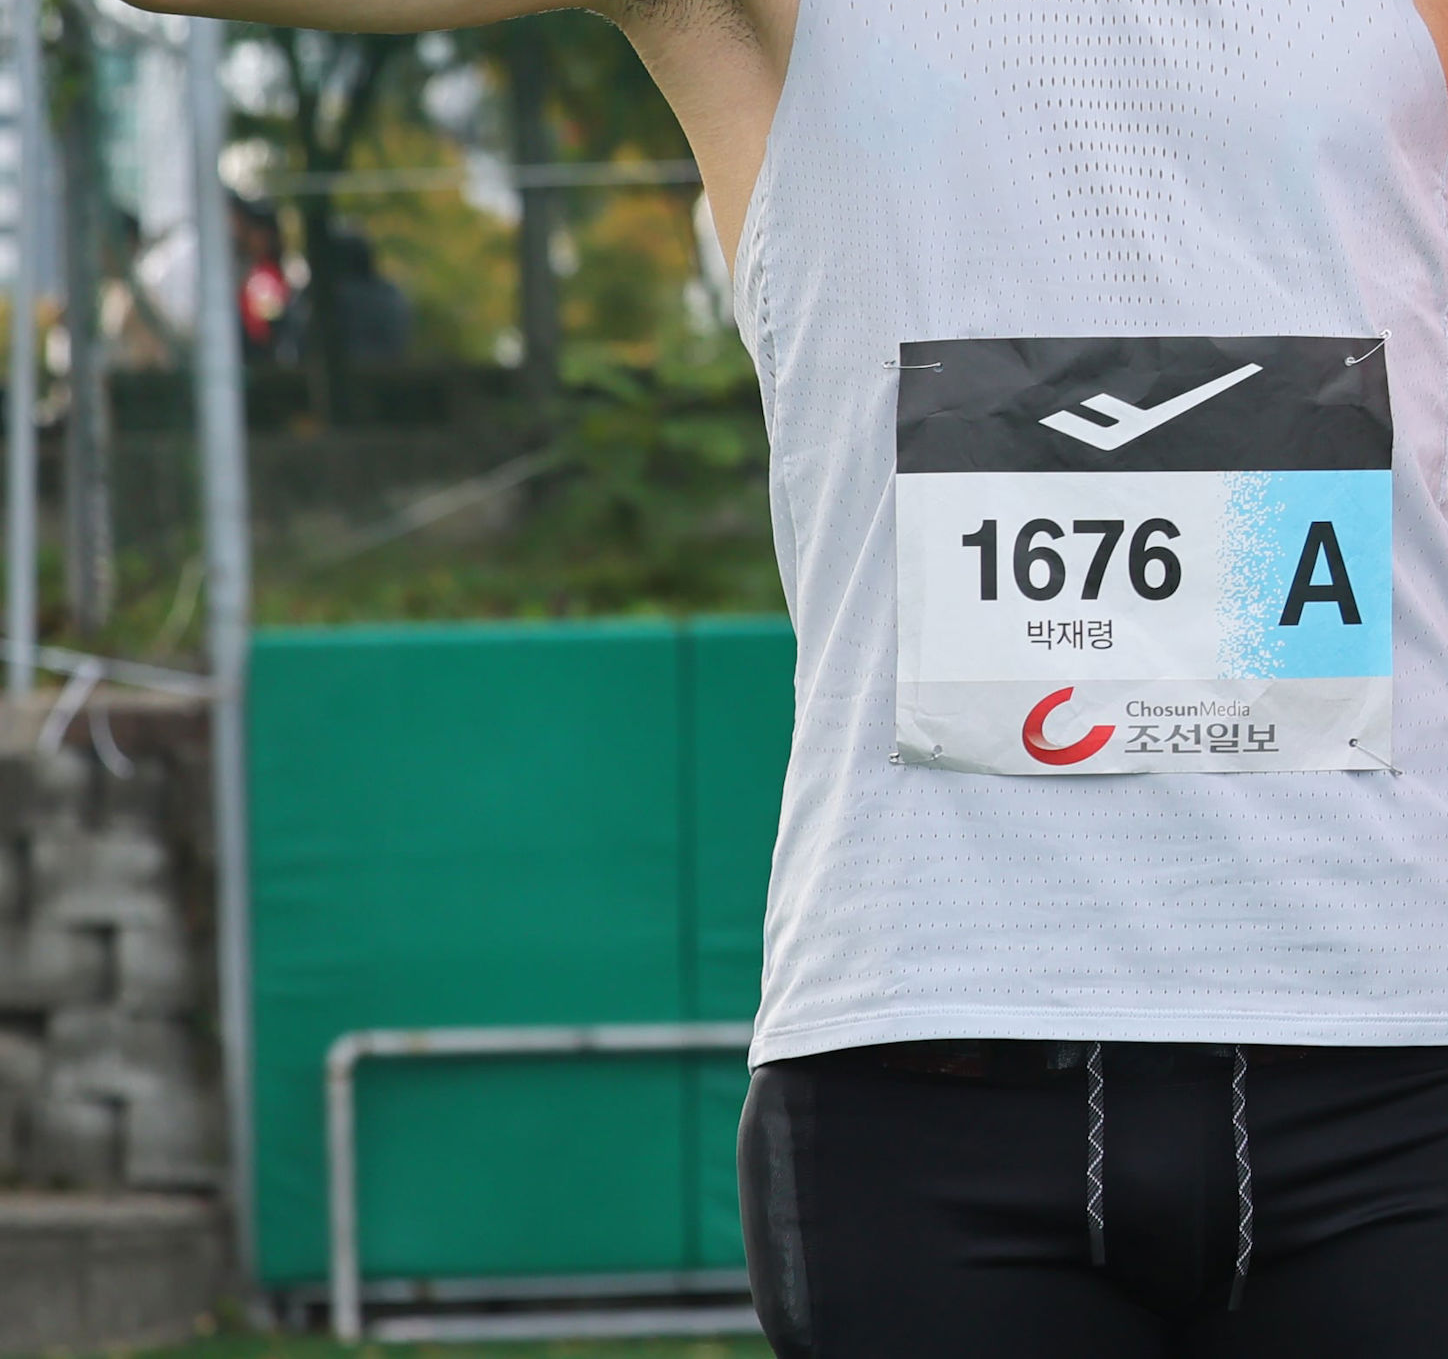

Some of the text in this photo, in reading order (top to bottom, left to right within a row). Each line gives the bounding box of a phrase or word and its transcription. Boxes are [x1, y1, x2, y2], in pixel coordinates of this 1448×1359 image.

[962, 518, 1182, 602] 1676
[1278, 521, 1363, 626] A
[1027, 619, 1113, 650] 박재령
[1125, 700, 1250, 718] ChosunMedia
[1124, 723, 1280, 754] 조선일보
